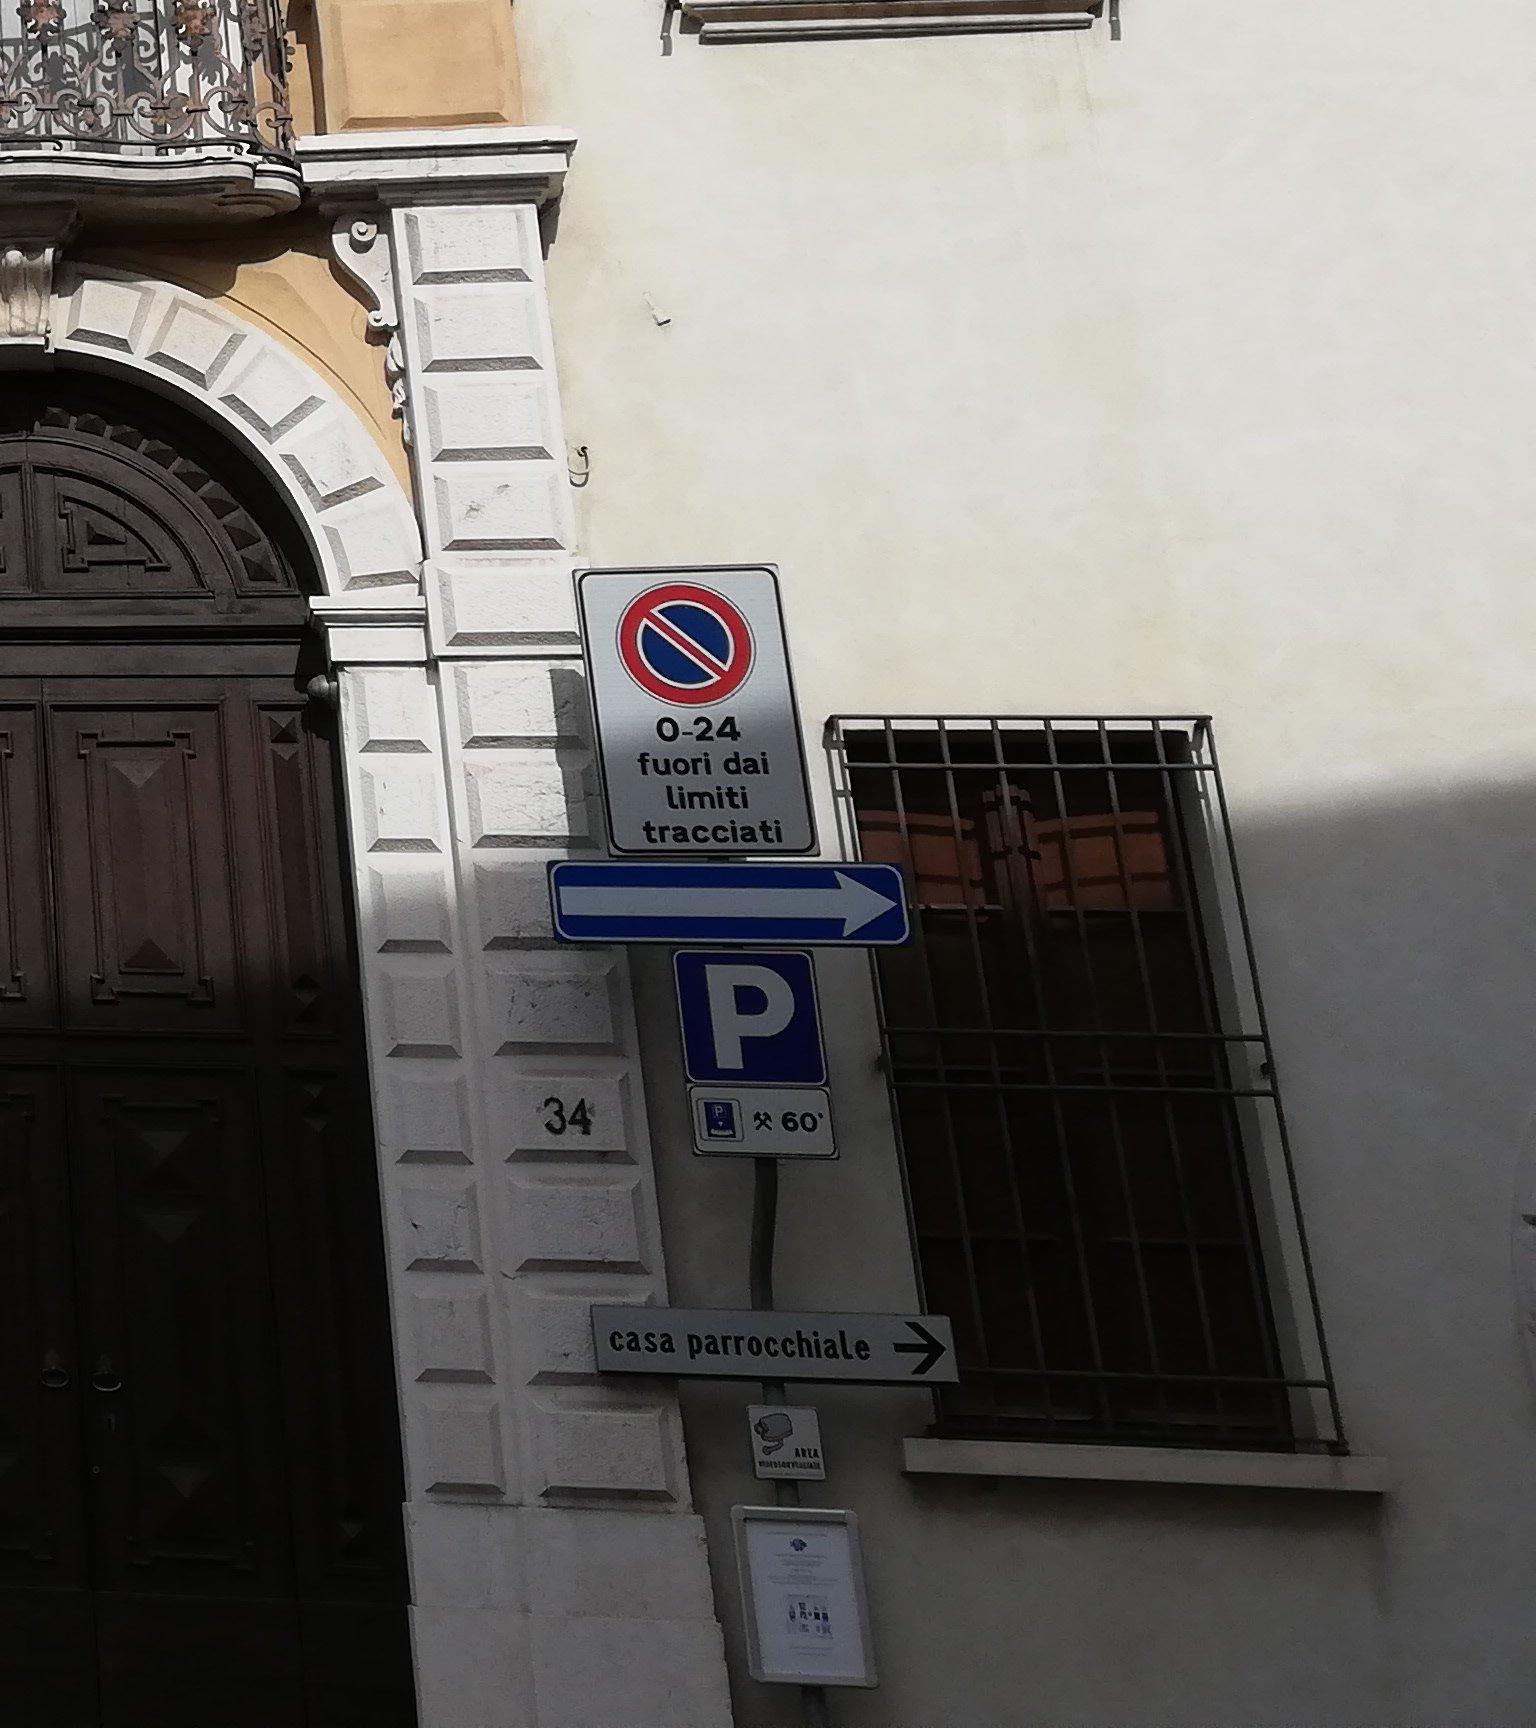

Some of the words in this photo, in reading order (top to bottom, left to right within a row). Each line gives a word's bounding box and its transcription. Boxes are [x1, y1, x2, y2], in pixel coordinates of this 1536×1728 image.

[656, 716, 741, 742] 0-24
[637, 751, 712, 776] fuori
[723, 751, 769, 775] dai
[665, 785, 749, 809] limiti
[642, 819, 783, 843] tracciati
[704, 964, 795, 1069] P
[543, 1096, 592, 1136] 34
[609, 1330, 676, 1353] casa
[686, 1330, 871, 1360] parrocchiale
[794, 1447, 820, 1459] AREA
